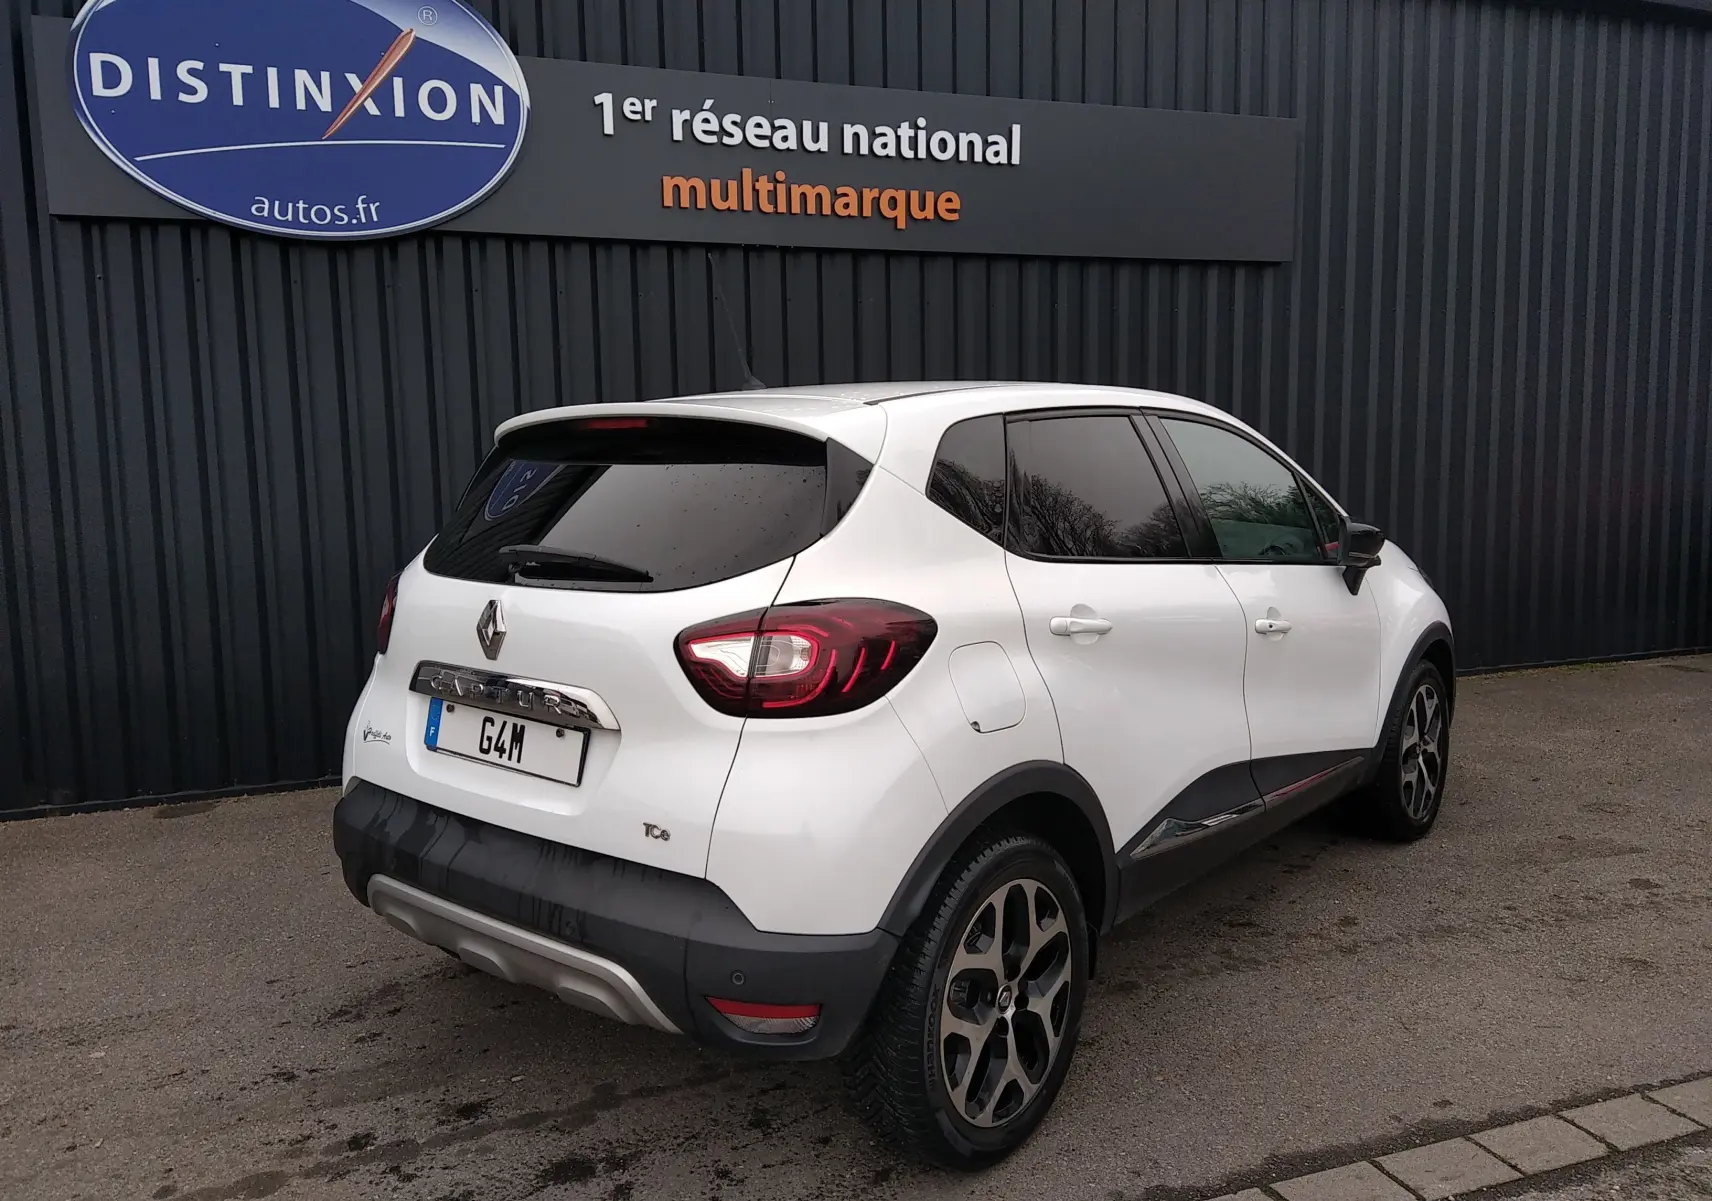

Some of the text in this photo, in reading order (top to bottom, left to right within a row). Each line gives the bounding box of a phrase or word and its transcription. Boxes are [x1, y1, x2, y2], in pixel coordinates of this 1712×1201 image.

[88, 50, 506, 127] DISTINXION
[593, 91, 1021, 166] 1er réseau national
[249, 193, 381, 226] autos.fr
[661, 167, 962, 230] multimarque
[430, 674, 563, 714] CAPTUR
[478, 716, 526, 763] G4M
